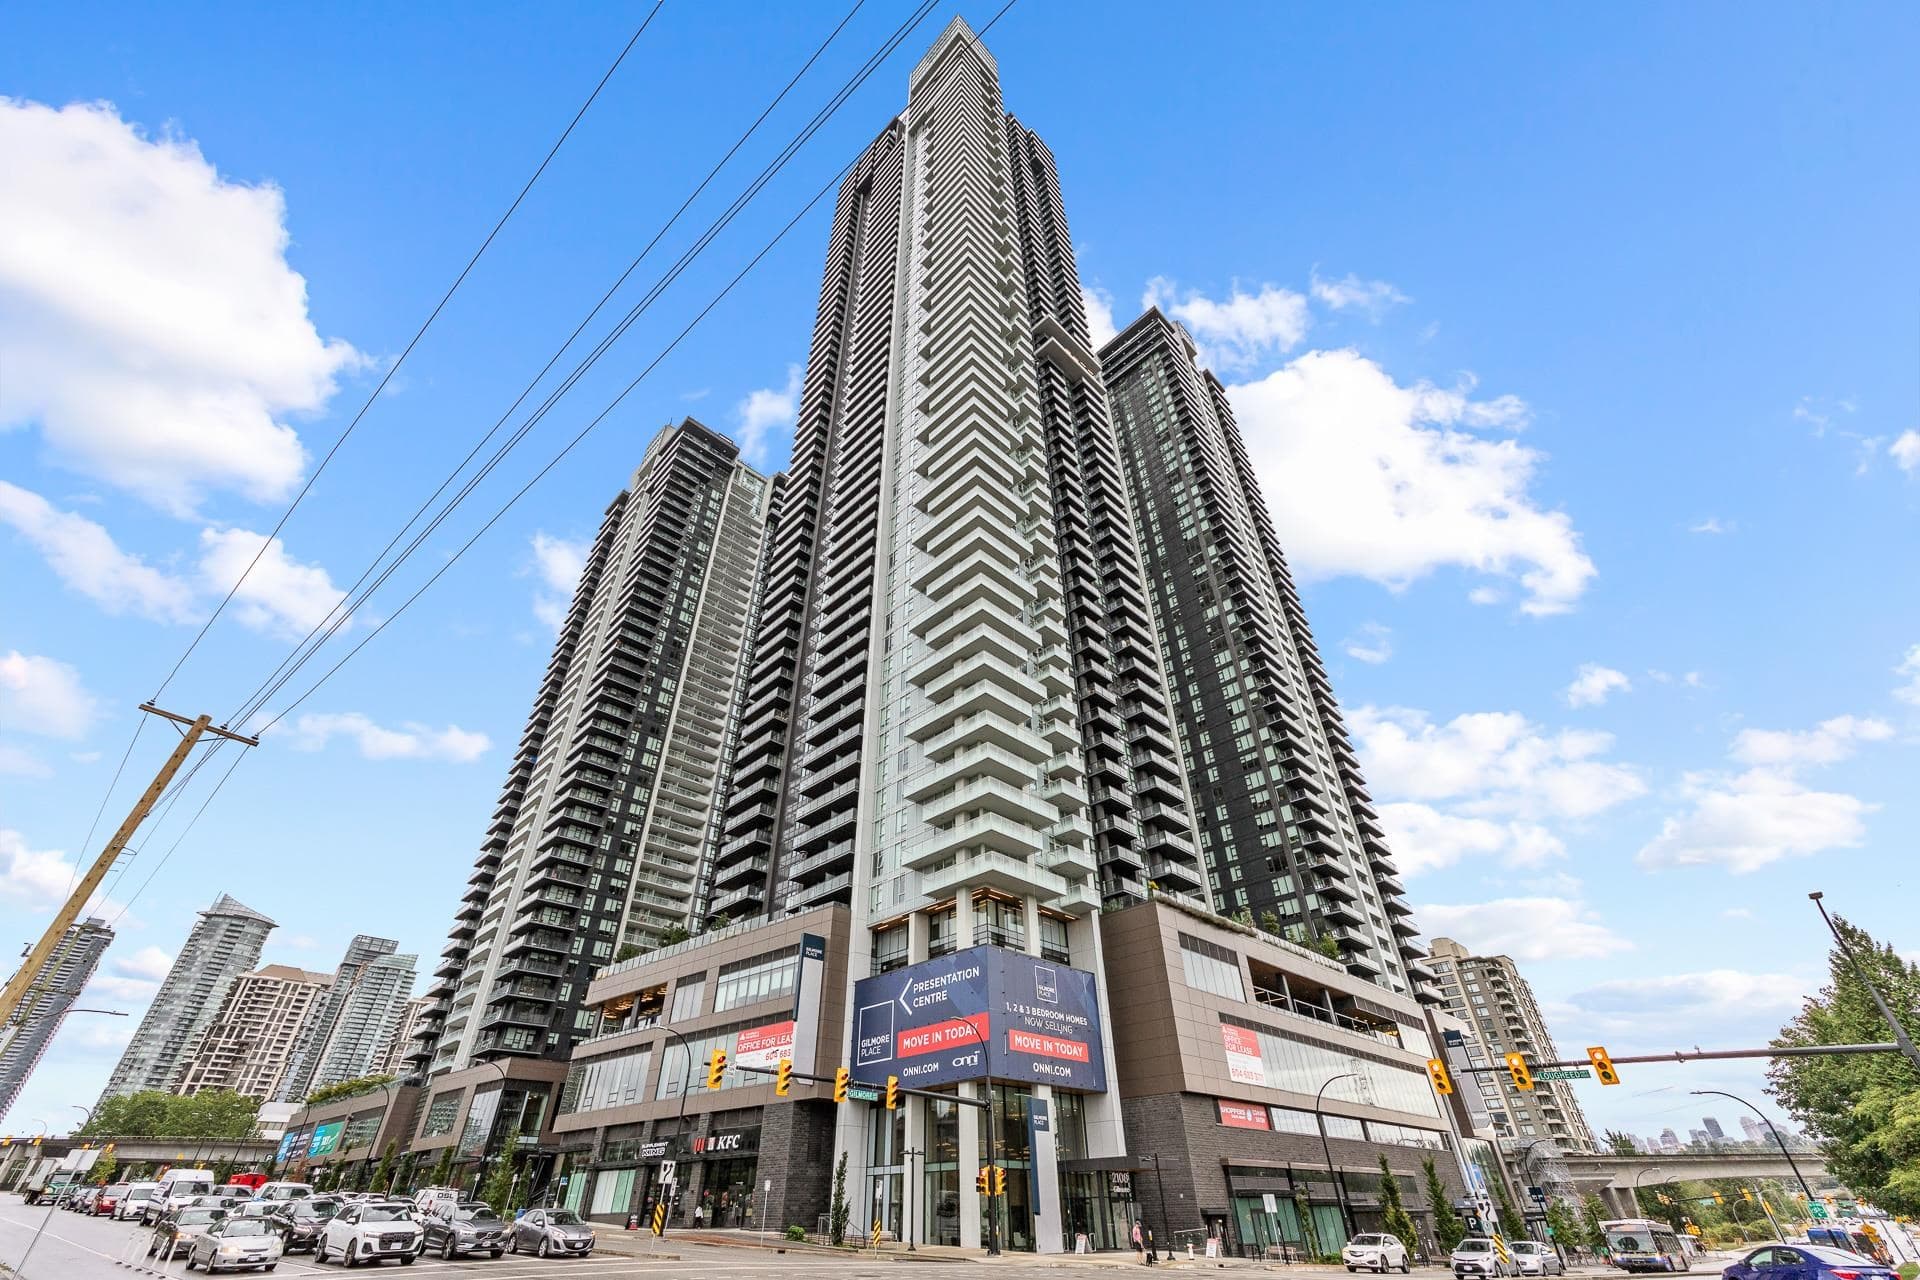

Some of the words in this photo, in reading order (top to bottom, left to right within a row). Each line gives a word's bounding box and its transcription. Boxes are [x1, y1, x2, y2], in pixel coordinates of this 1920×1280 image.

[913, 966, 980, 994] PRESENTATION
[1038, 985, 1055, 993] GILMORE
[912, 990, 948, 1008] CENTRE
[1006, 1002, 1011, 1012] 1,
[1013, 1003, 1018, 1012] 2
[1019, 1005, 1024, 1014] &
[1025, 1006, 1031, 1015] 3
[1031, 1007, 1065, 1021] BEDROOM
[1065, 1014, 1088, 1026] HOMES
[1024, 1016, 1044, 1028] NOW
[1045, 1020, 1073, 1034] SELLING
[861, 1034, 890, 1048] GILMORE
[903, 1033, 929, 1049] MOVE
[932, 1031, 942, 1044] IN
[945, 1023, 978, 1041] TODAY
[1224, 1034, 1242, 1045] OFFICE
[737, 1040, 761, 1053] OFFICE
[761, 1036, 777, 1049] FOR
[861, 1045, 881, 1057] PLACE
[1014, 1035, 1041, 1050] MOVE
[1043, 1041, 1053, 1052] IN
[1055, 1042, 1083, 1057] TODAY
[1225, 1042, 1237, 1053] FOR
[1237, 1044, 1253, 1056] LEASE
[952, 1050, 980, 1067] onni
[903, 1062, 939, 1077] ONNI.COM
[1033, 1062, 1072, 1078] ONNI.COM
[1540, 1071, 1581, 1080] LOUGHEED
[849, 1090, 874, 1099] GILMORE
[1221, 1107, 1246, 1115] SHOPPERS
[716, 1135, 740, 1150] KFC
[641, 1147, 666, 1158] KING
[1468, 1217, 1477, 1229] P
